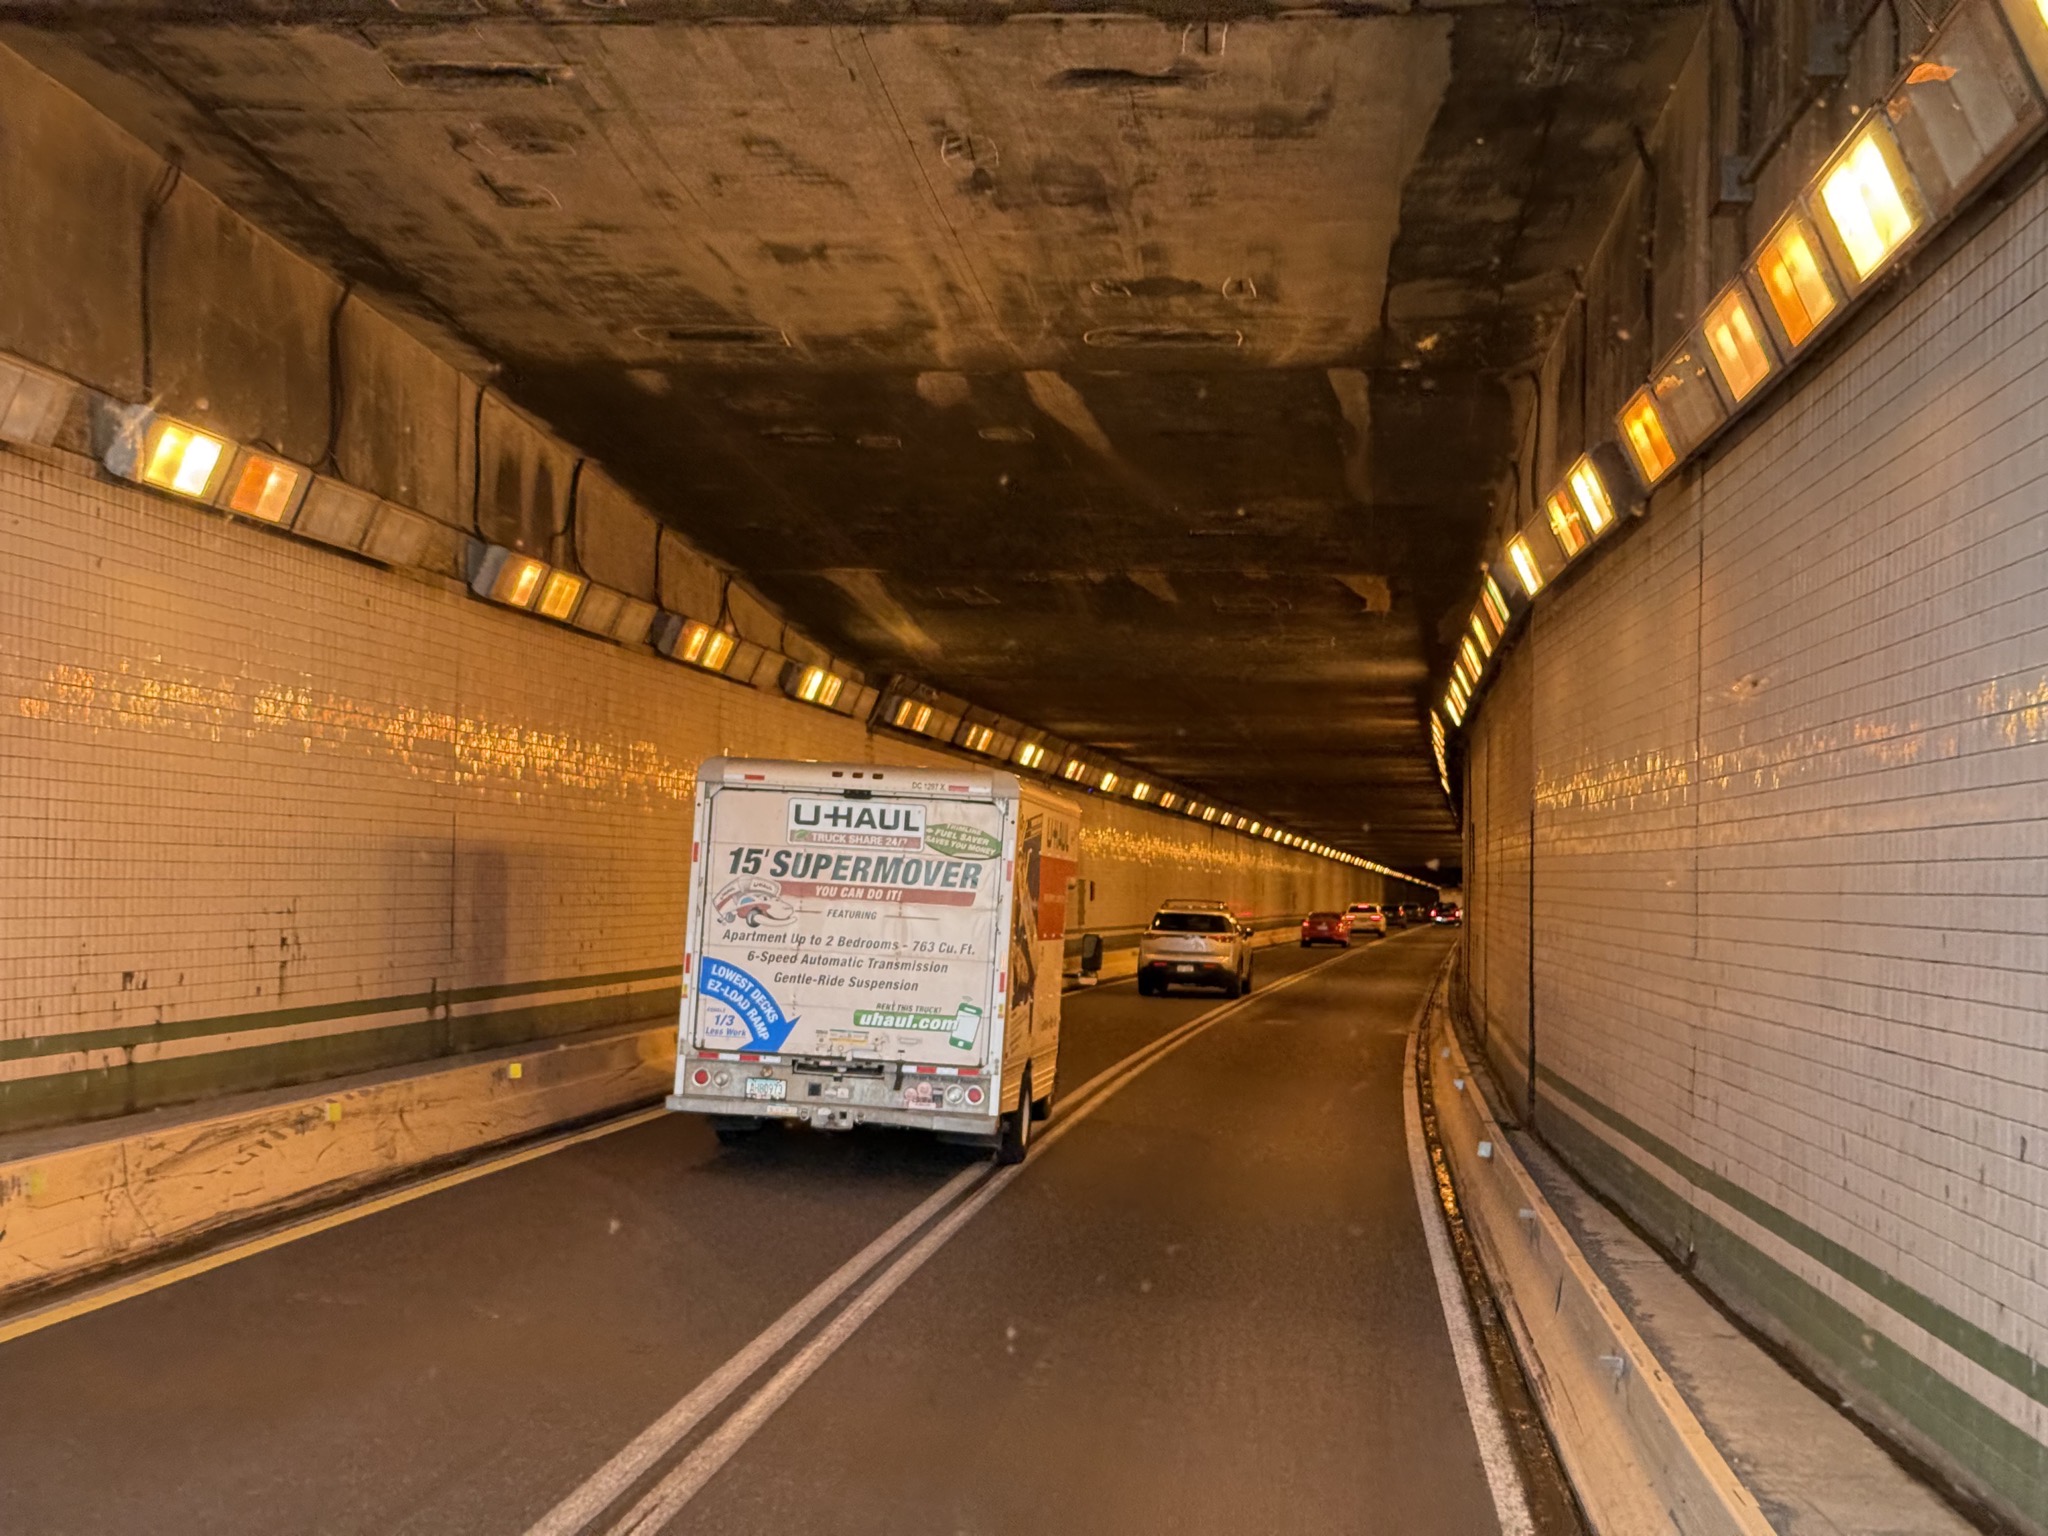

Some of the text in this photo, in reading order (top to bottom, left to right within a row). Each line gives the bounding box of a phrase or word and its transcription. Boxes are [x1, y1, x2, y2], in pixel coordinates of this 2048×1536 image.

[911, 781, 922, 790] DC
[794, 803, 920, 832] U-HAUL
[811, 832, 908, 847] TRUCK SHARE 24/7
[925, 835, 996, 856] SAVES YOU MONEY
[934, 827, 989, 846] FUEL SAVER
[770, 849, 982, 889] SUPERMOVER
[815, 884, 903, 902] YOU CAN DO IT!
[826, 908, 878, 920] FEATURING
[722, 929, 787, 943] Apartment
[790, 933, 806, 946] Up
[809, 934, 822, 946] to
[825, 935, 834, 947] 2
[837, 936, 899, 951] Bedrooms
[912, 940, 935, 953] 763
[938, 941, 957, 954] Cu.
[960, 943, 975, 956] Ft.
[747, 950, 949, 973] 6-Speed Automatic Transmission
[774, 971, 919, 991] Gentle-Ride Suspension
[711, 964, 779, 1024] LOWEST DECKS
[707, 978, 770, 1040] EZ-LOAD RAMP
[876, 1002, 895, 1012] RENT
[897, 1004, 913, 1012] THIS
[715, 1014, 735, 1026] 1/3
[859, 1012, 959, 1032] uhaul.com
[705, 1026, 746, 1037] Less Work
